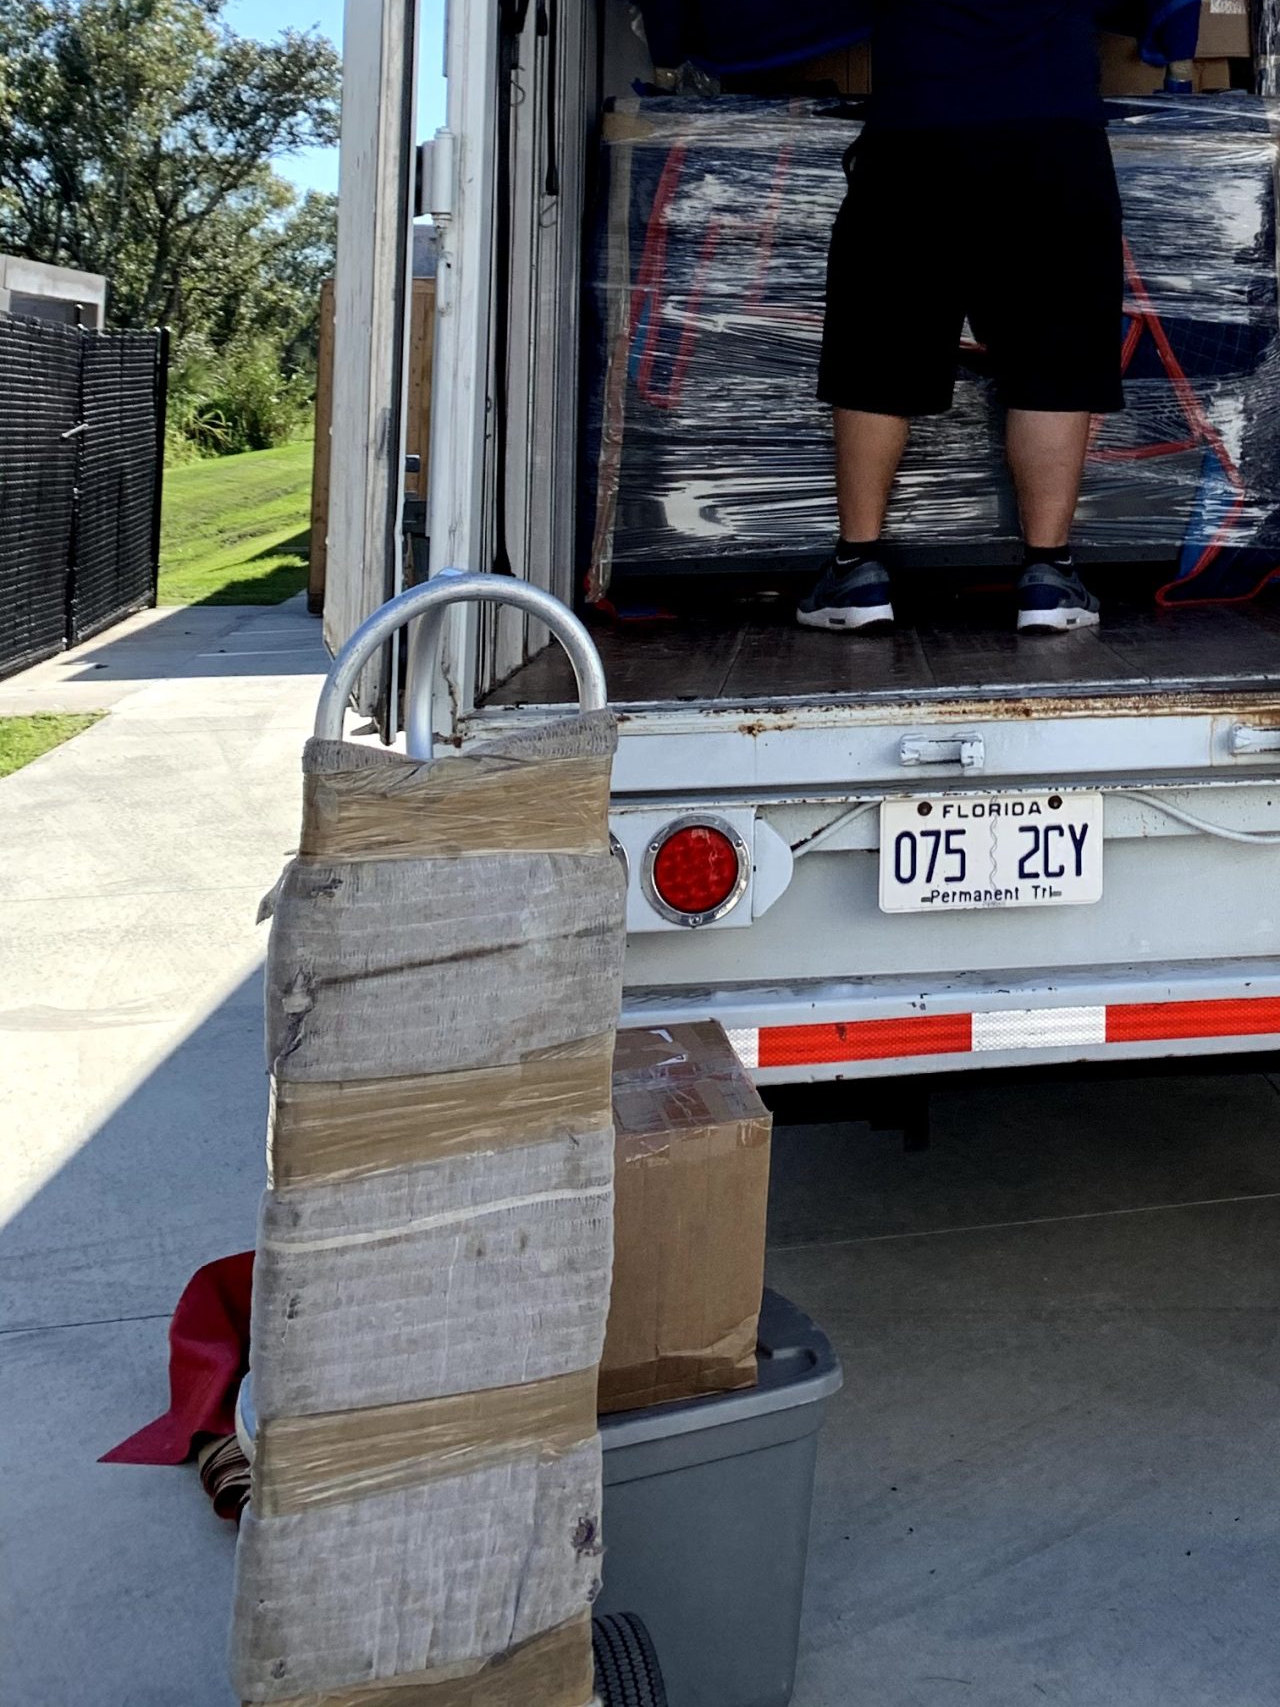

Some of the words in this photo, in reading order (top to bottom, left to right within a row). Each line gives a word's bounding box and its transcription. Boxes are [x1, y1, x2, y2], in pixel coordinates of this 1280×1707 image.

[942, 801, 1042, 819] FLORIDA
[894, 828, 966, 884] 075
[1018, 822, 1089, 881] 2CY
[931, 887, 1019, 903] Permanent
[1031, 885, 1055, 900] Trl
